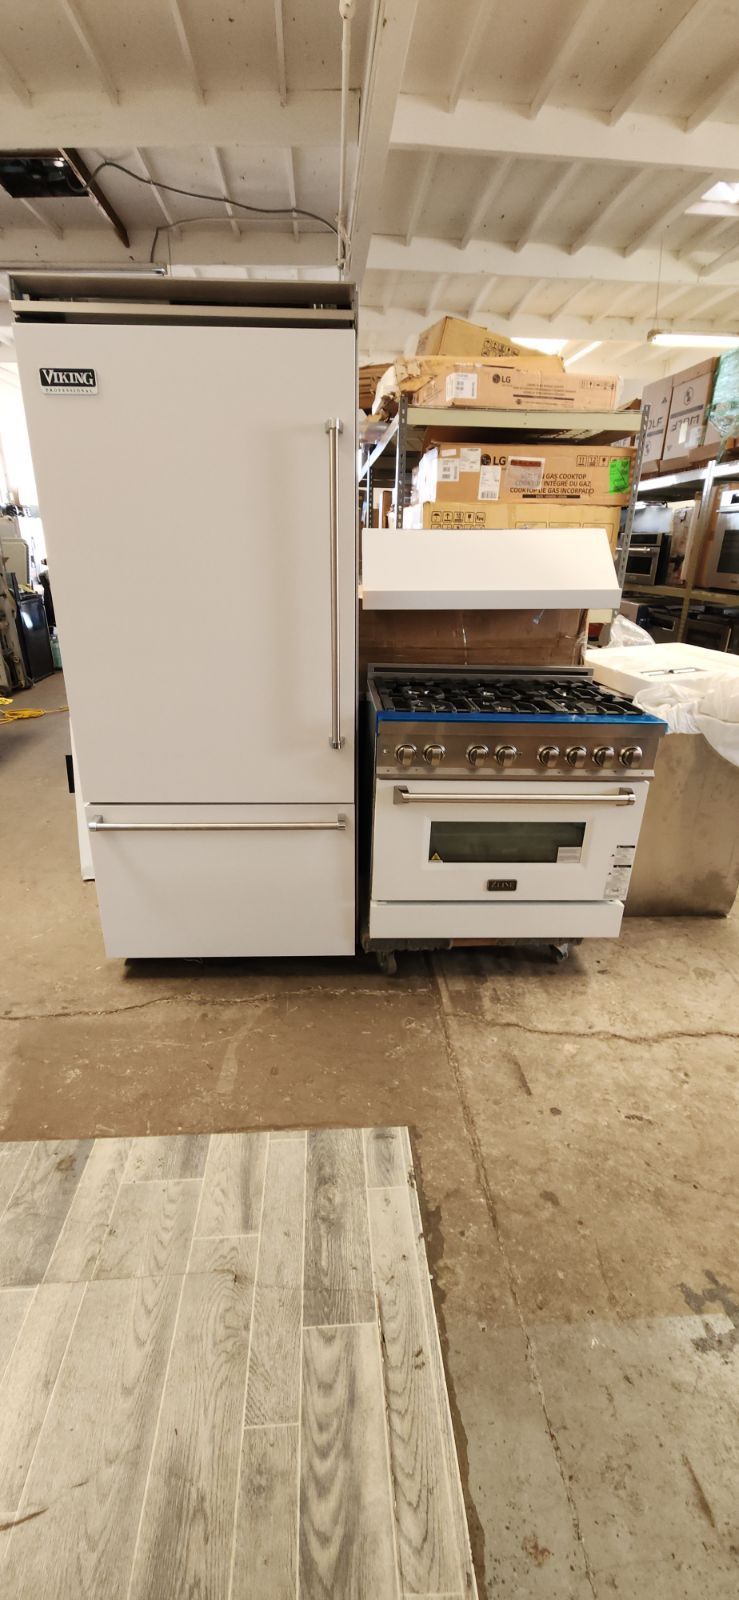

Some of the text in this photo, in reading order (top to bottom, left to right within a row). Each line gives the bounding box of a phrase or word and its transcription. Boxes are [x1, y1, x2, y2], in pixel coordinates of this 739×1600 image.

[41, 369, 94, 386] VIKING
[501, 376, 511, 384] LG
[493, 456, 506, 466] LG
